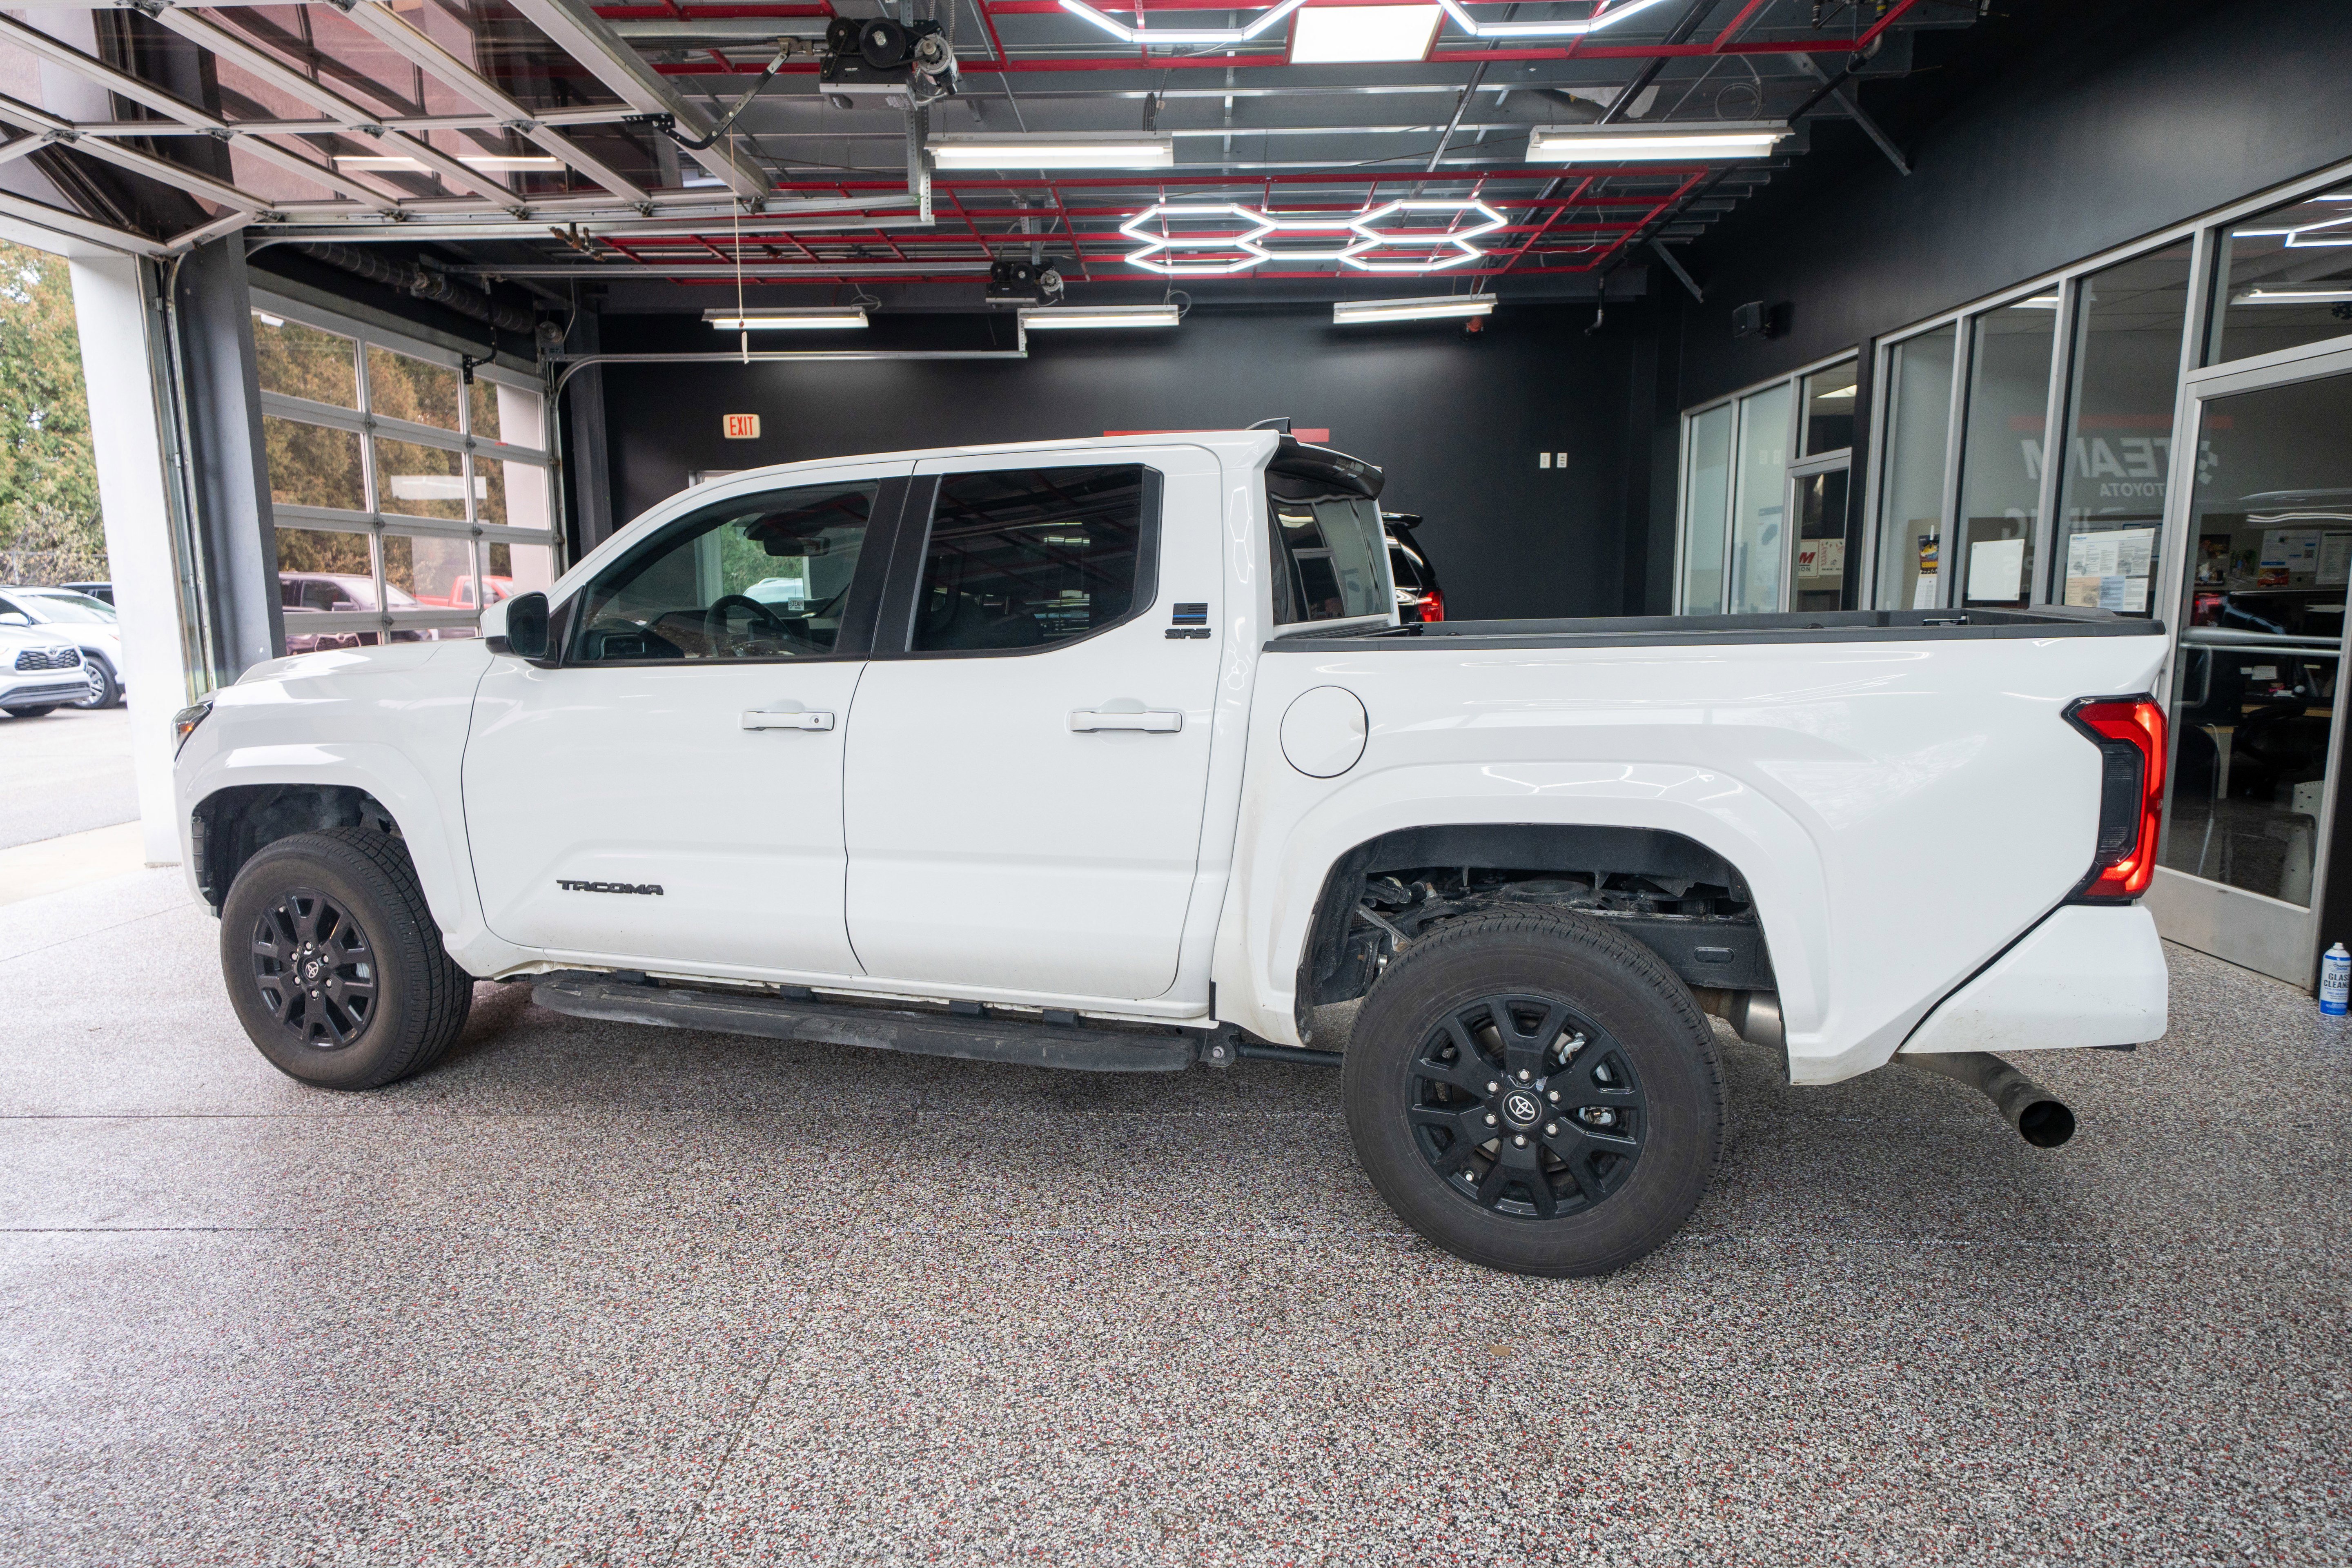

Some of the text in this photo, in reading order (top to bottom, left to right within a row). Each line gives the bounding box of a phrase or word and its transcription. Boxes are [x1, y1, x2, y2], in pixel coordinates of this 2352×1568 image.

[729, 416, 753, 436] EXIT
[1165, 628, 1211, 639] SR5
[556, 879, 664, 895] TACOMA
